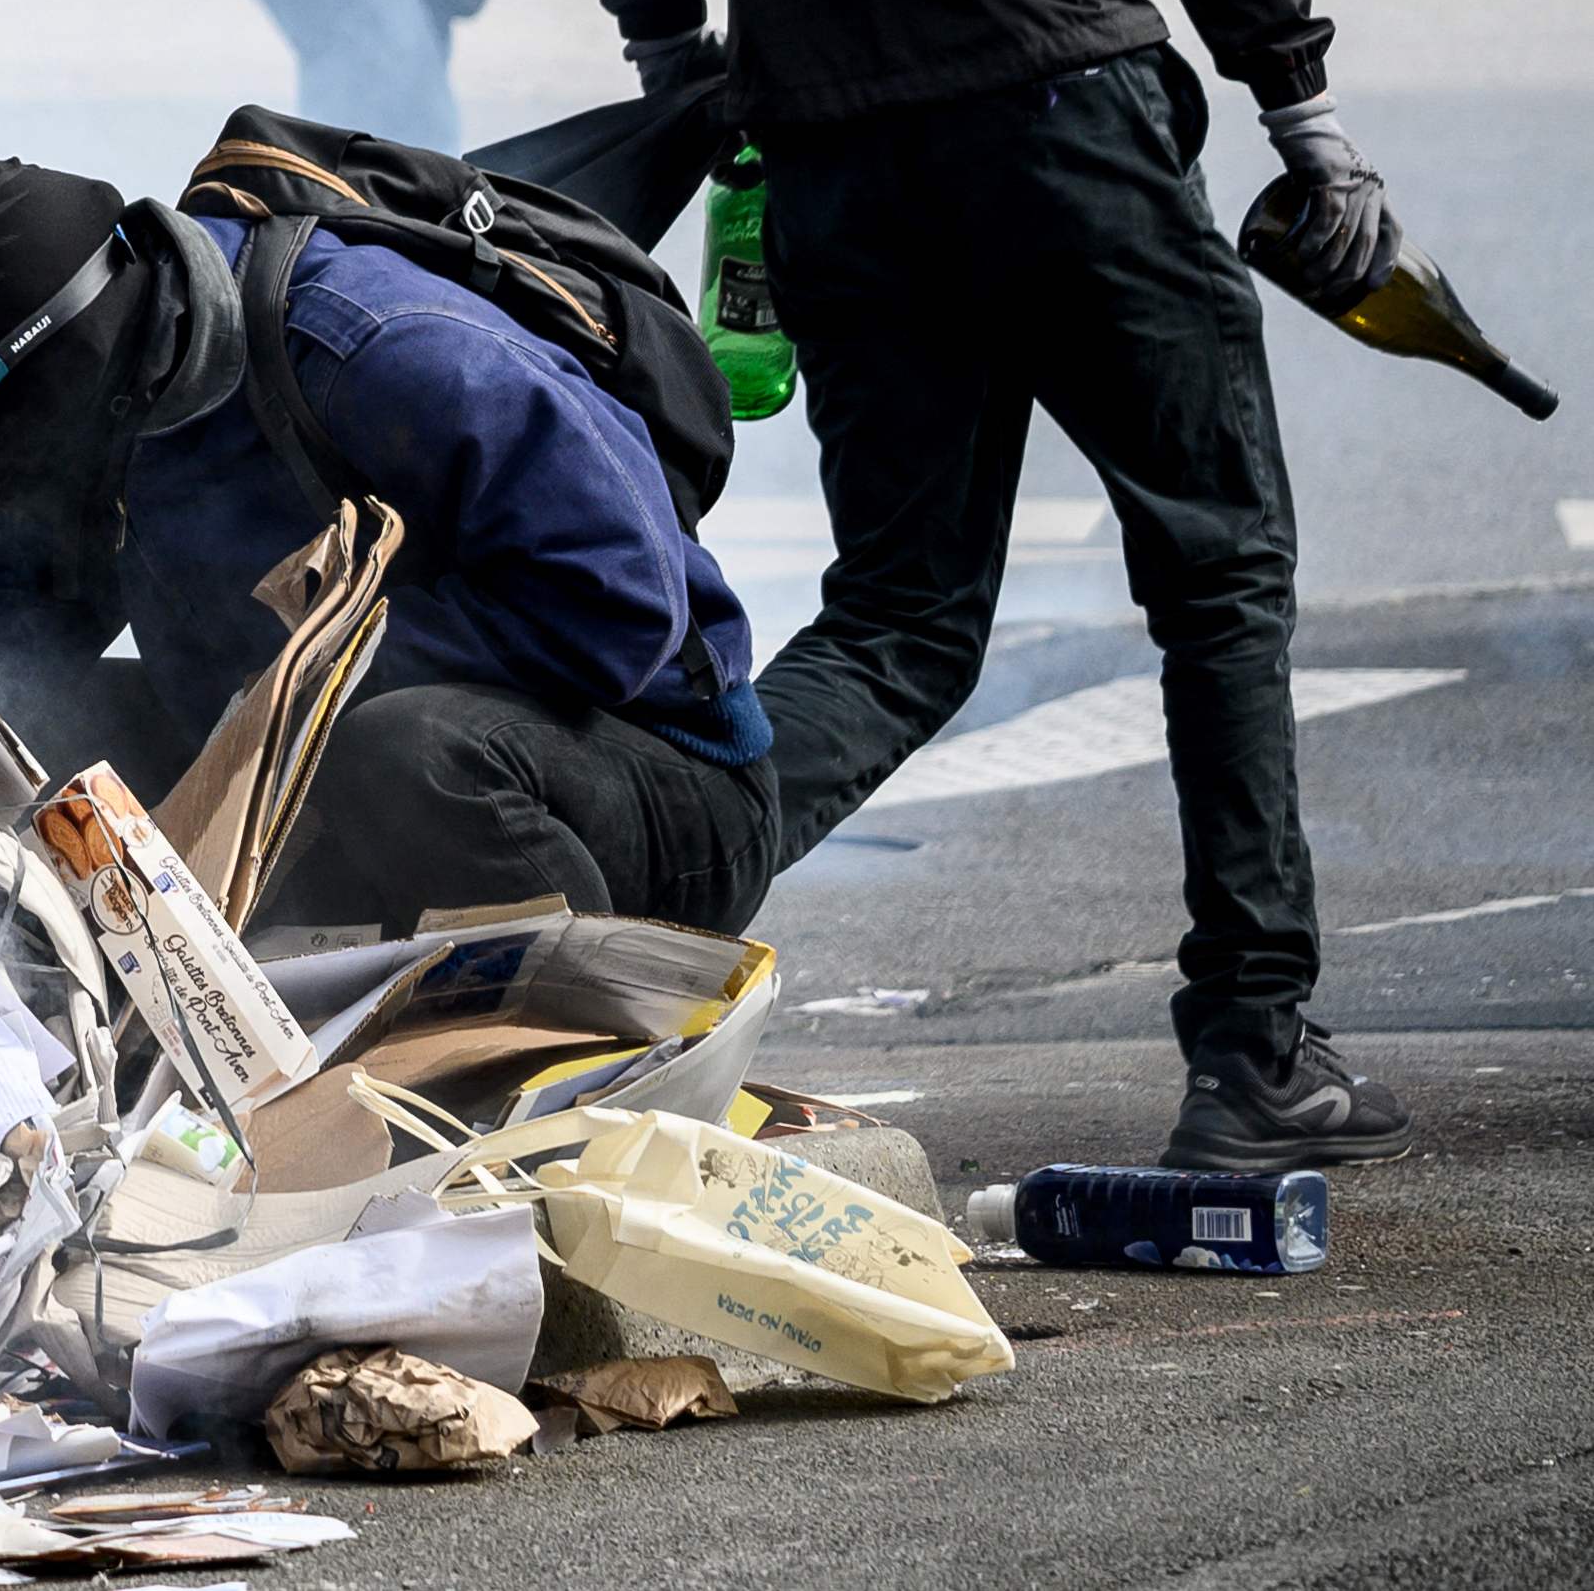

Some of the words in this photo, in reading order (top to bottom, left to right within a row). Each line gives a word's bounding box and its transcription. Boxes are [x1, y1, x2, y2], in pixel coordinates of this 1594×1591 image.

[10, 315, 52, 353] NABAIJI
[164, 933, 209, 990] Galettes
[204, 989, 257, 1058] Bretonnes
[188, 996, 251, 1084] Pont-Aven
[758, 1313, 783, 1332] NO
